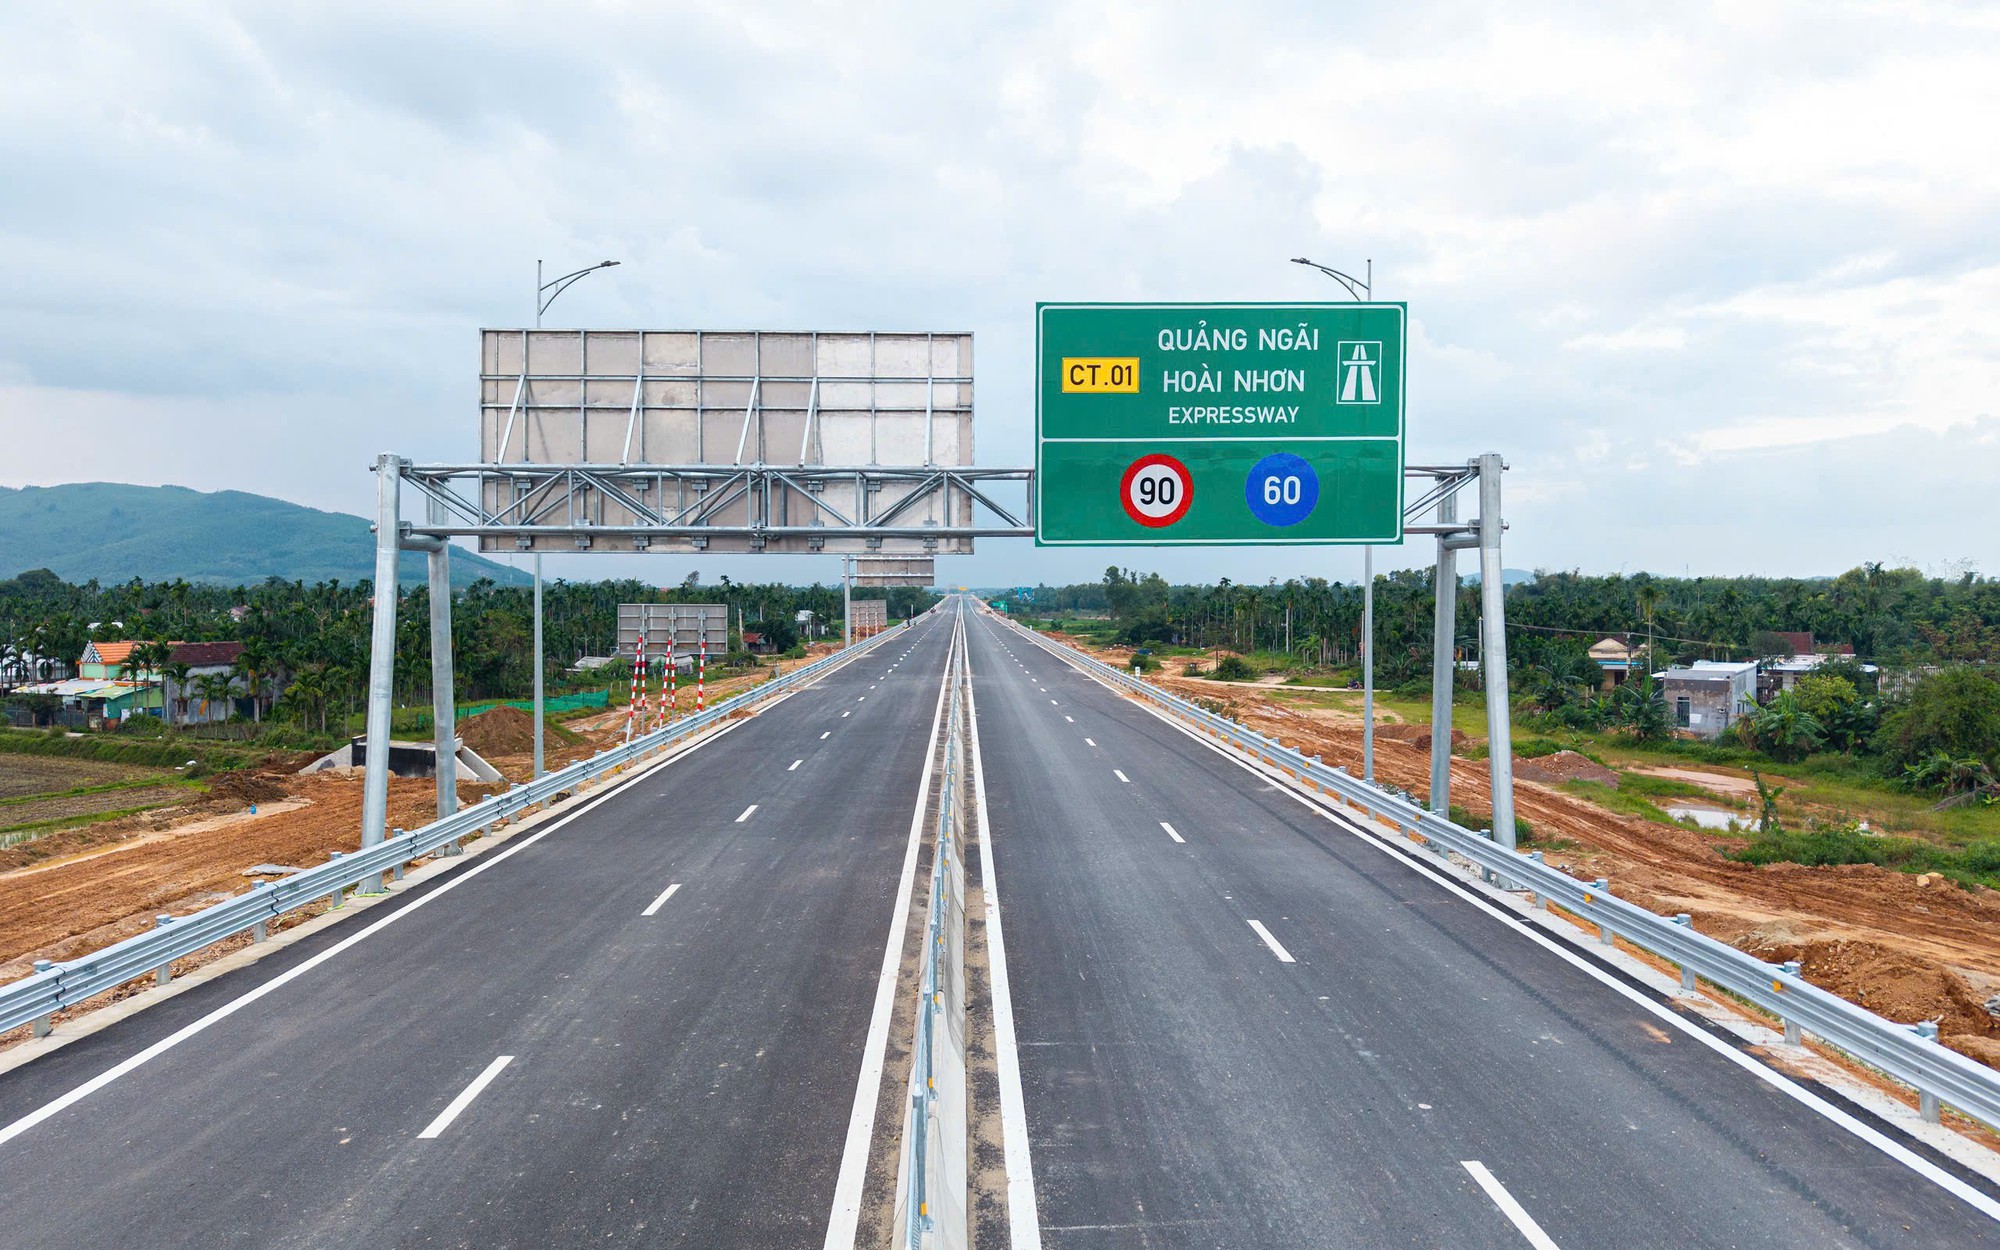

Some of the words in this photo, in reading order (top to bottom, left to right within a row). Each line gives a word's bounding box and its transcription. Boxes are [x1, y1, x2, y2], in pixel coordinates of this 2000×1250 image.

[1158, 320, 1247, 351] QUẢNG
[1258, 323, 1319, 351] NGÃI
[1070, 364, 1132, 386] CT.01
[1163, 363, 1222, 393] HOÀI
[1234, 368, 1305, 392] NHƠN
[1168, 406, 1300, 424] EXPRESSWAY
[1139, 476, 1175, 506] 90
[1263, 475, 1301, 505] 60
